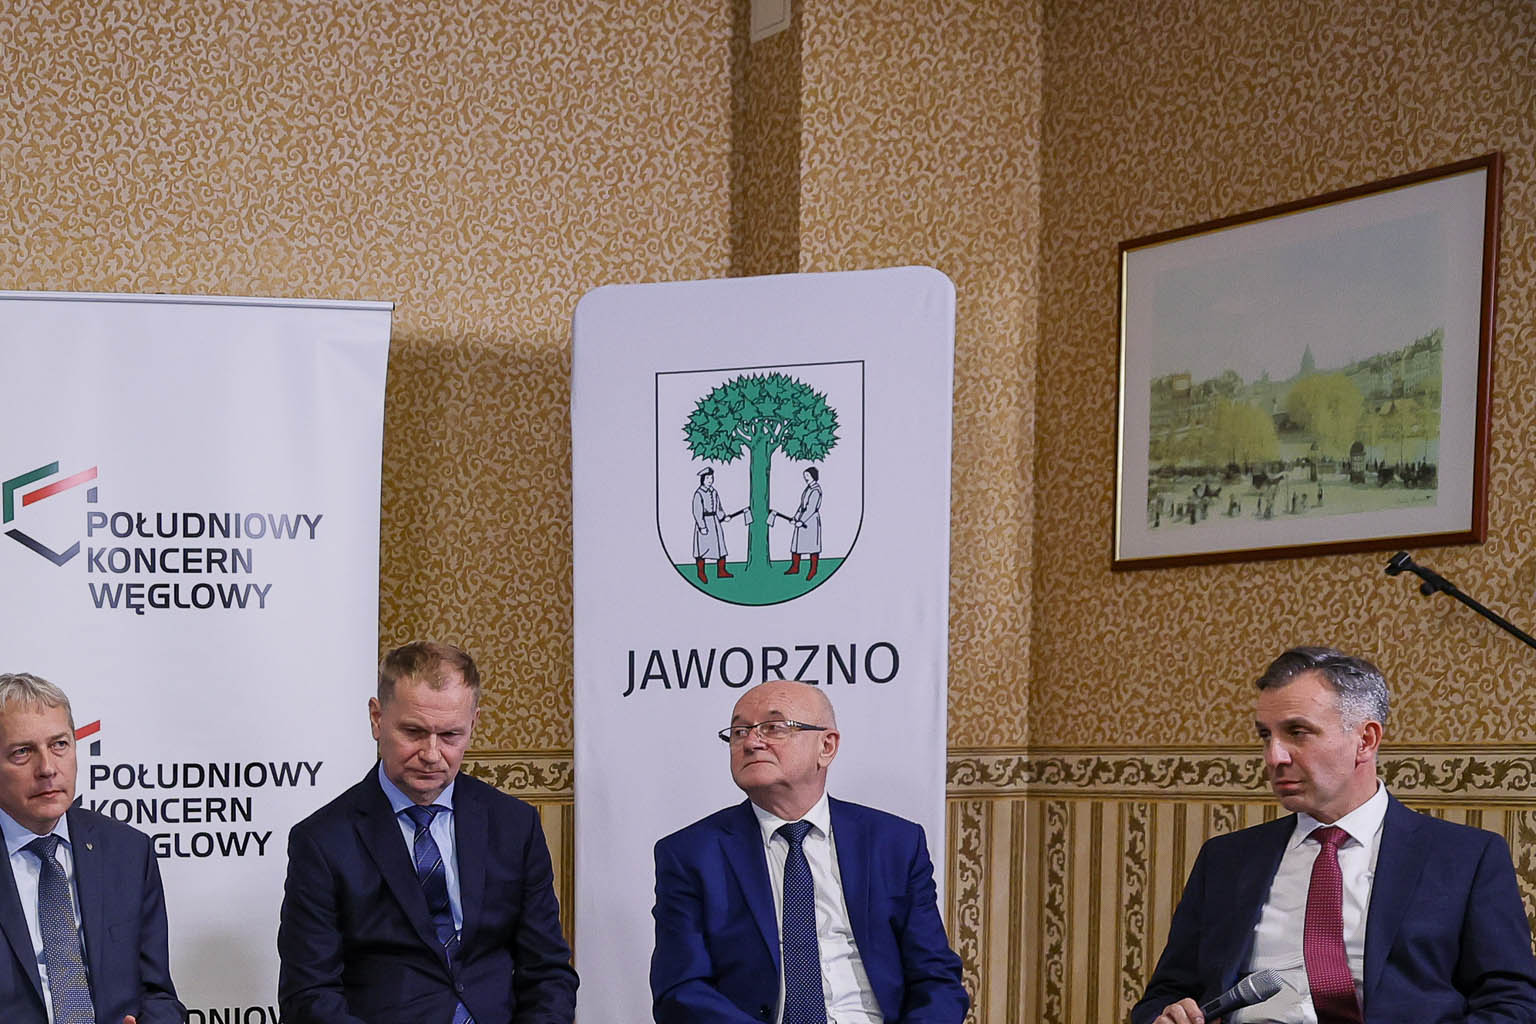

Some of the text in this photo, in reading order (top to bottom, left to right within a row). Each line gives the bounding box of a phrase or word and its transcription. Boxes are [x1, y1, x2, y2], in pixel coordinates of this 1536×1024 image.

[86, 511, 323, 540] POŁUDNIOWY
[87, 547, 252, 573] KONCERN
[88, 582, 272, 615] WĘGLOWY
[623, 641, 900, 697] JAWORZNO
[90, 761, 323, 790] POŁUDNIOWY
[151, 831, 272, 859] GLOWY
